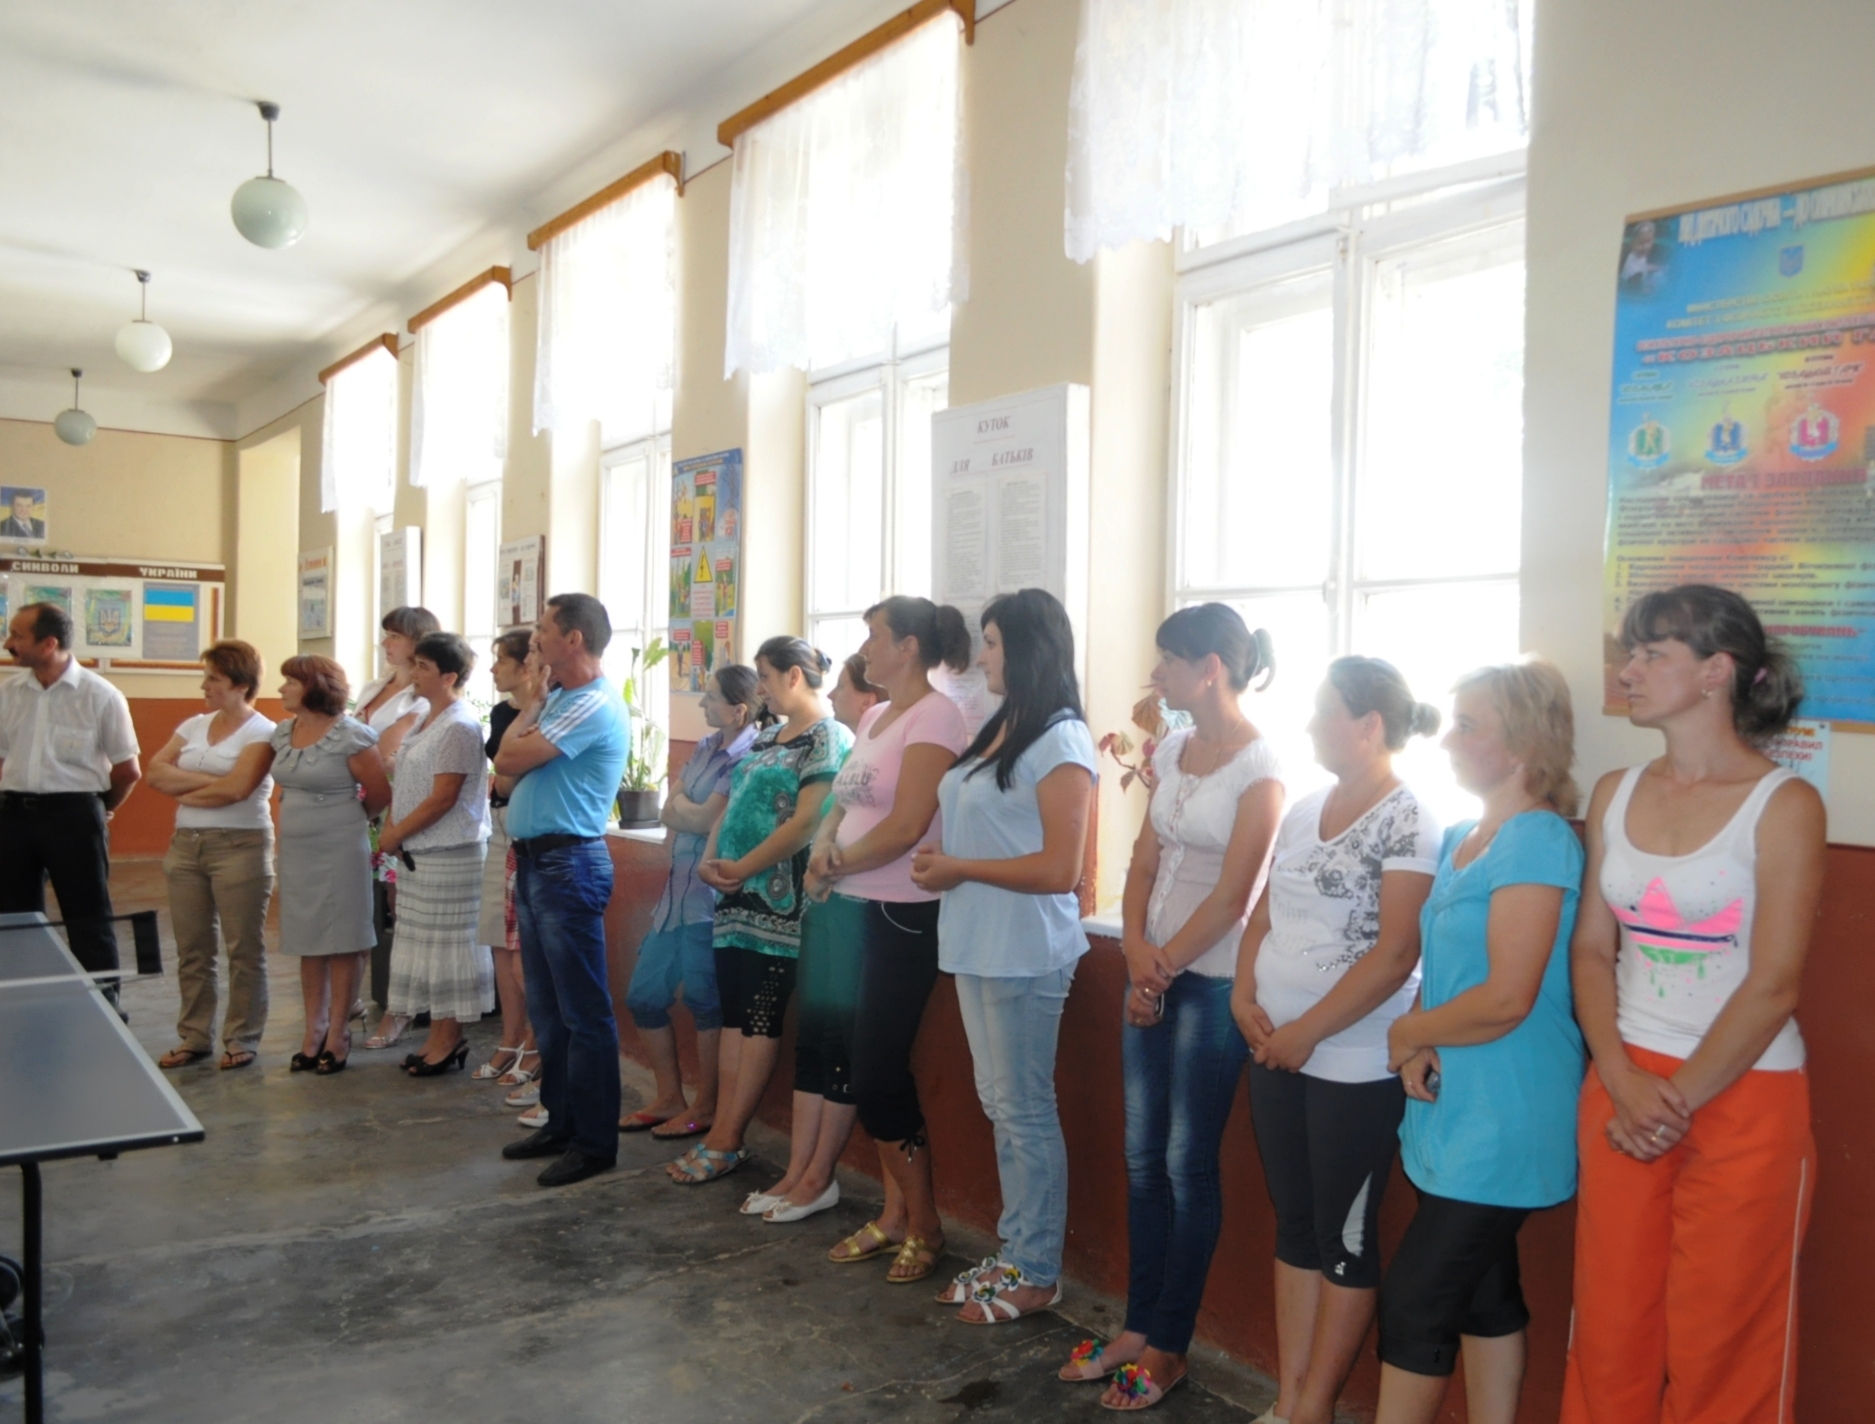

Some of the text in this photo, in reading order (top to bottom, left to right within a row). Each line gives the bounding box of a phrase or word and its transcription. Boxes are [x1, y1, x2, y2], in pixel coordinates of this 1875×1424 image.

[977, 415, 1011, 434] КУТОК
[991, 447, 1034, 466] БАТЬКІВ
[1701, 473, 1745, 489] МЕТА
[11, 561, 198, 579] СИМВОЛИ УКРАЇНИ
